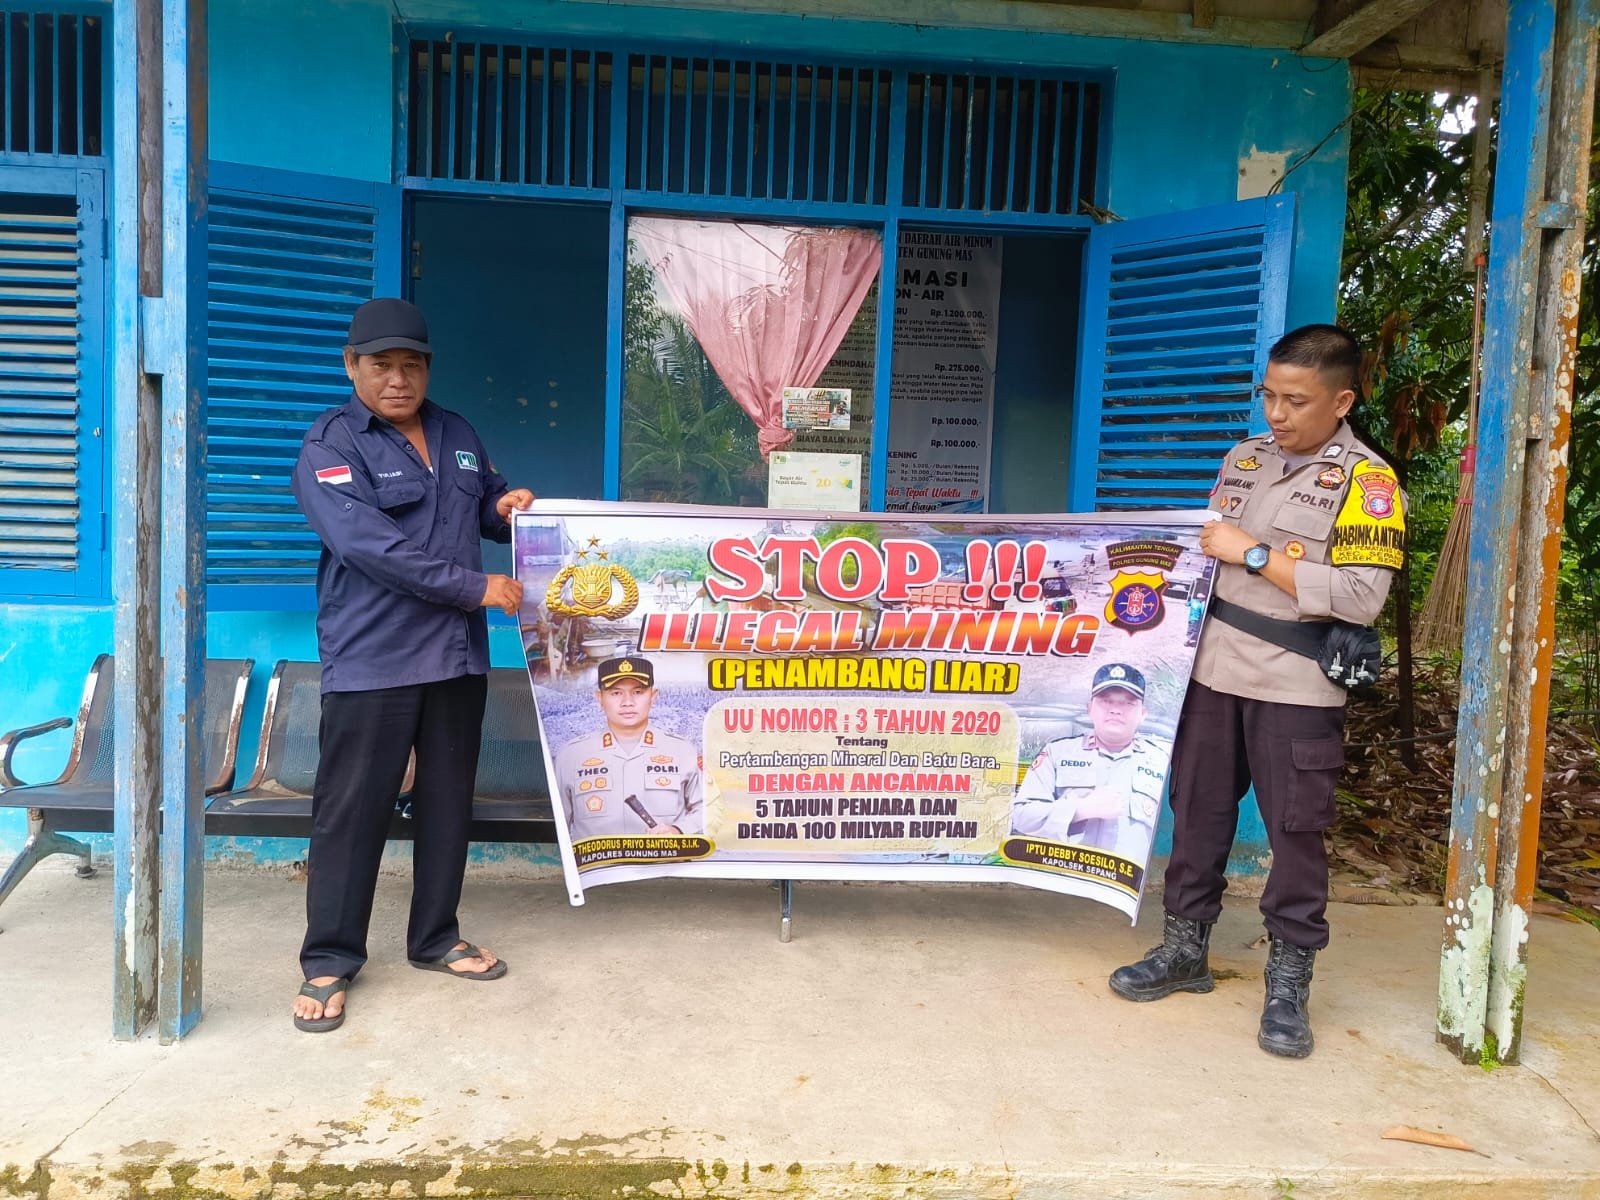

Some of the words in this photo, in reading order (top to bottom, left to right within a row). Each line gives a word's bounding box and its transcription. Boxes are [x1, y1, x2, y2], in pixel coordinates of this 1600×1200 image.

[905, 233, 941, 245] DAERAH
[944, 235, 960, 246] AIR
[964, 236, 993, 248] MINUM
[898, 247, 914, 258] TEN
[917, 248, 952, 260] GUNUNG
[955, 250, 973, 261] MAS
[896, 269, 968, 287] MASI
[921, 290, 945, 301] AIR
[895, 307, 908, 316] RU
[828, 360, 875, 368] EMINDAHA
[946, 417, 982, 427] 100.000,-
[797, 435, 820, 443] BIAYA
[822, 436, 845, 444] BALIK
[945, 440, 981, 449] 100.000,-
[887, 451, 918, 459] KENING
[905, 487, 929, 499] Tepat
[932, 487, 961, 498] Waktu
[1290, 491, 1334, 510] POLRI
[886, 502, 908, 511] emat
[1110, 544, 1153, 554] KALIMANTAN
[1154, 544, 1180, 554] TENGAH
[705, 536, 941, 603] STOP
[963, 539, 1048, 602] !!!
[1112, 558, 1135, 567] POLRES
[1159, 559, 1172, 567] MAS
[638, 609, 866, 653] ILLEGAL
[871, 610, 1101, 656] MINING
[708, 657, 926, 692] (PENAMBANG
[930, 660, 1020, 695] LIAR)
[724, 708, 753, 732] UU
[761, 708, 837, 732] NOMOR
[843, 713, 850, 732] :
[855, 709, 868, 733] 3
[874, 709, 945, 734] TAHUN
[951, 711, 1001, 735] 2020
[835, 735, 889, 749] Tentang
[719, 751, 828, 770] Pertambangan
[831, 751, 888, 768] Mineral
[890, 753, 919, 768] Dan
[922, 753, 957, 768] Batu
[961, 754, 1001, 769] Bara.
[1060, 759, 1093, 768] DEBBY
[577, 767, 609, 777] THEO
[646, 765, 679, 773] POLRI
[1137, 765, 1164, 782] POLRI
[748, 773, 845, 793] DENGAN
[849, 773, 971, 793] ANCAMAN
[756, 799, 768, 818] 5
[772, 799, 834, 817] TAHUN
[838, 799, 915, 816] PENJARA
[919, 799, 957, 816] DAN
[738, 822, 798, 839] DENDA
[801, 822, 834, 839] 100
[840, 821, 905, 839] MILYAR
[909, 821, 978, 839] RUPIAH
[578, 839, 621, 855] THEODORUS
[622, 840, 644, 850] PRIYO
[646, 839, 680, 850] SANTOSA,
[681, 839, 700, 849] S.I.K.
[581, 850, 623, 864] KAPOLRES
[624, 850, 659, 858] GUNUNG
[661, 849, 678, 857] MAS
[1026, 843, 1047, 856] IPTU
[1048, 845, 1077, 861] DEBBY
[1078, 850, 1117, 872] SOESILO,
[1119, 864, 1134, 878] S.E.
[1042, 857, 1084, 872] KAPOLSEK
[1085, 865, 1117, 880] SEPANG
